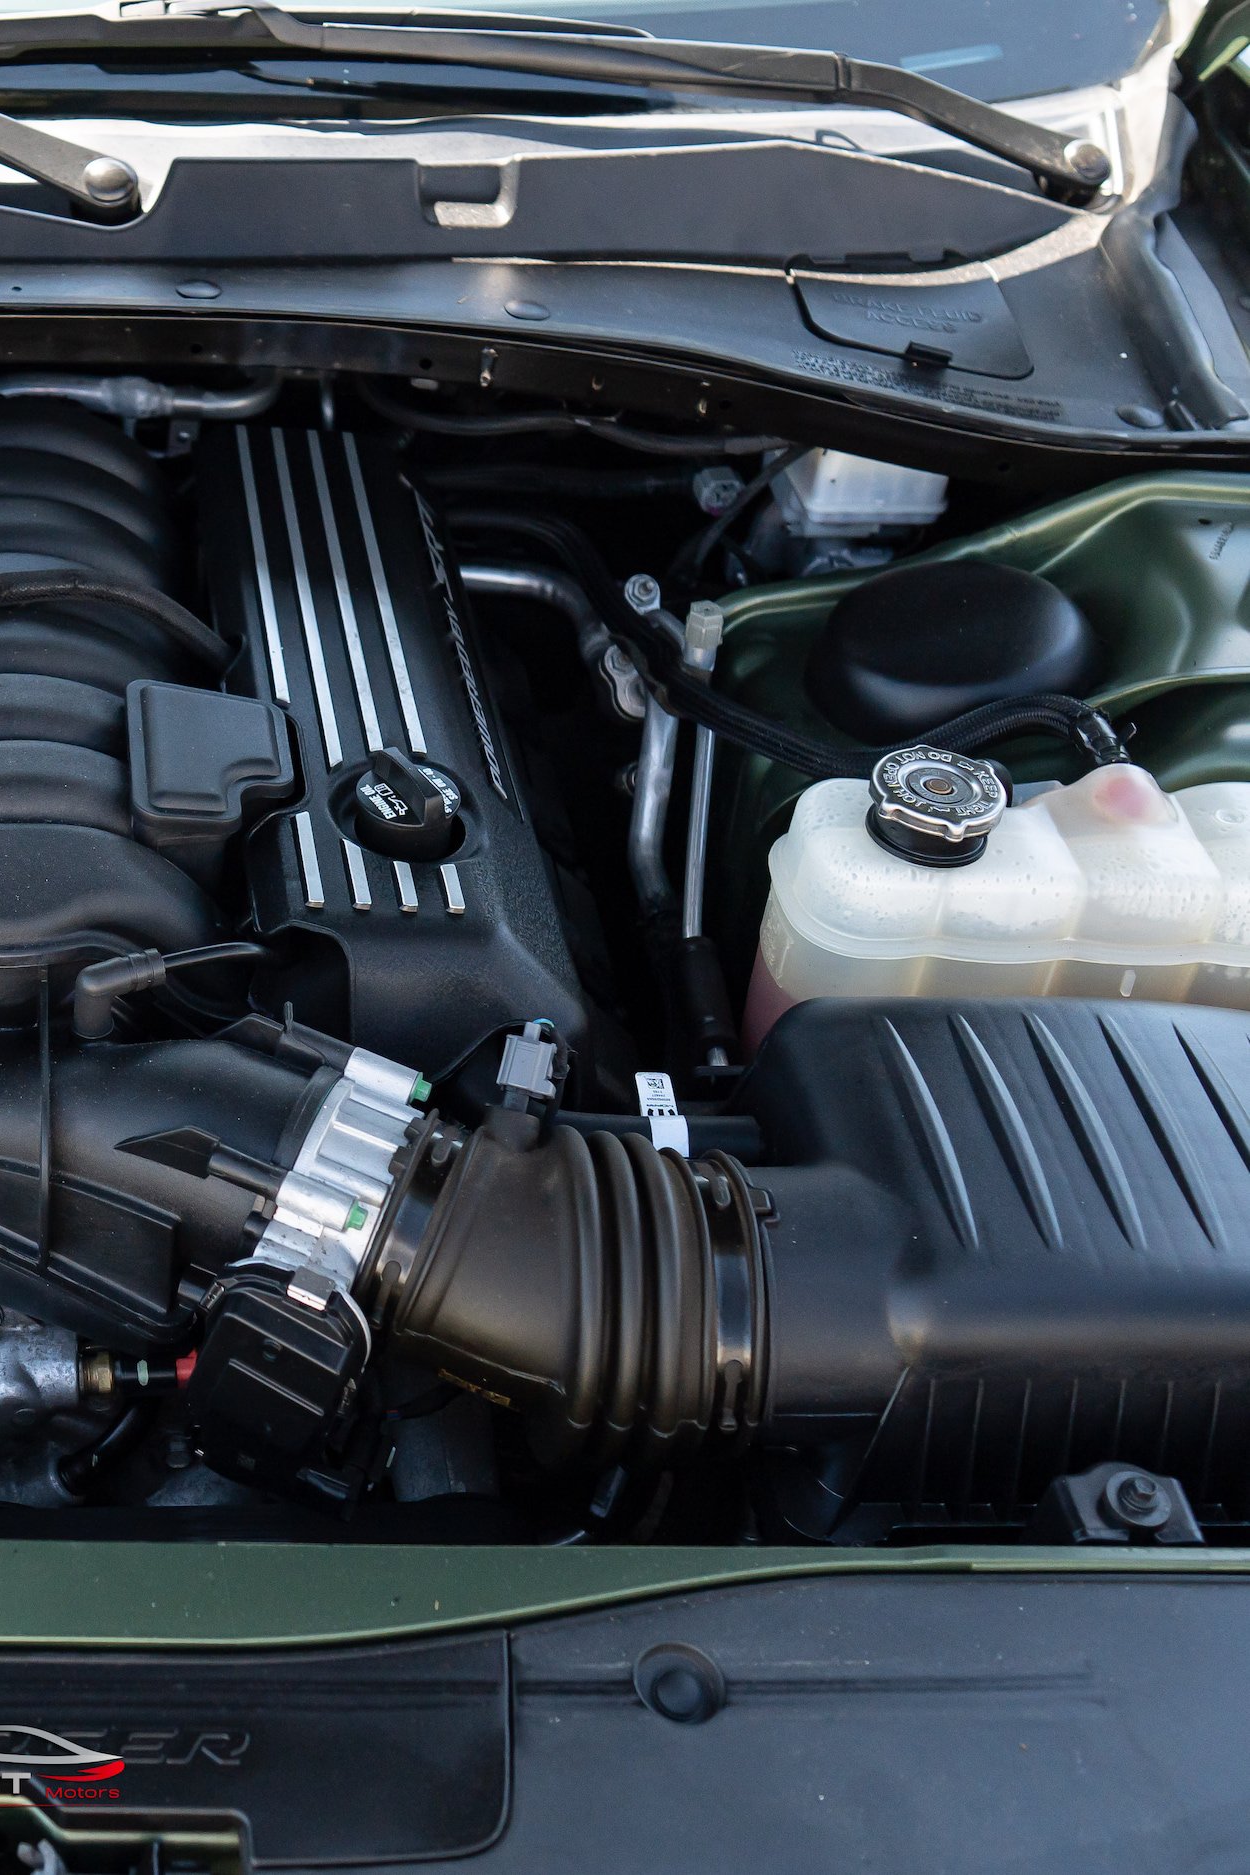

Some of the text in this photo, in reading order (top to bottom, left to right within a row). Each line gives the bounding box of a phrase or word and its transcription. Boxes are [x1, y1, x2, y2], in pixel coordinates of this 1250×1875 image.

[832, 293, 983, 323] BRAKE FLUID
[867, 309, 957, 334] ACCESS
[455, 640, 508, 800] POWERED
[895, 751, 926, 765] NOT
[927, 751, 953, 763] DO
[882, 762, 901, 788] OPEN
[360, 783, 397, 820] ENGINE OIL
[893, 788, 927, 808] HOT
[954, 770, 998, 817] KEEP TIGHT
